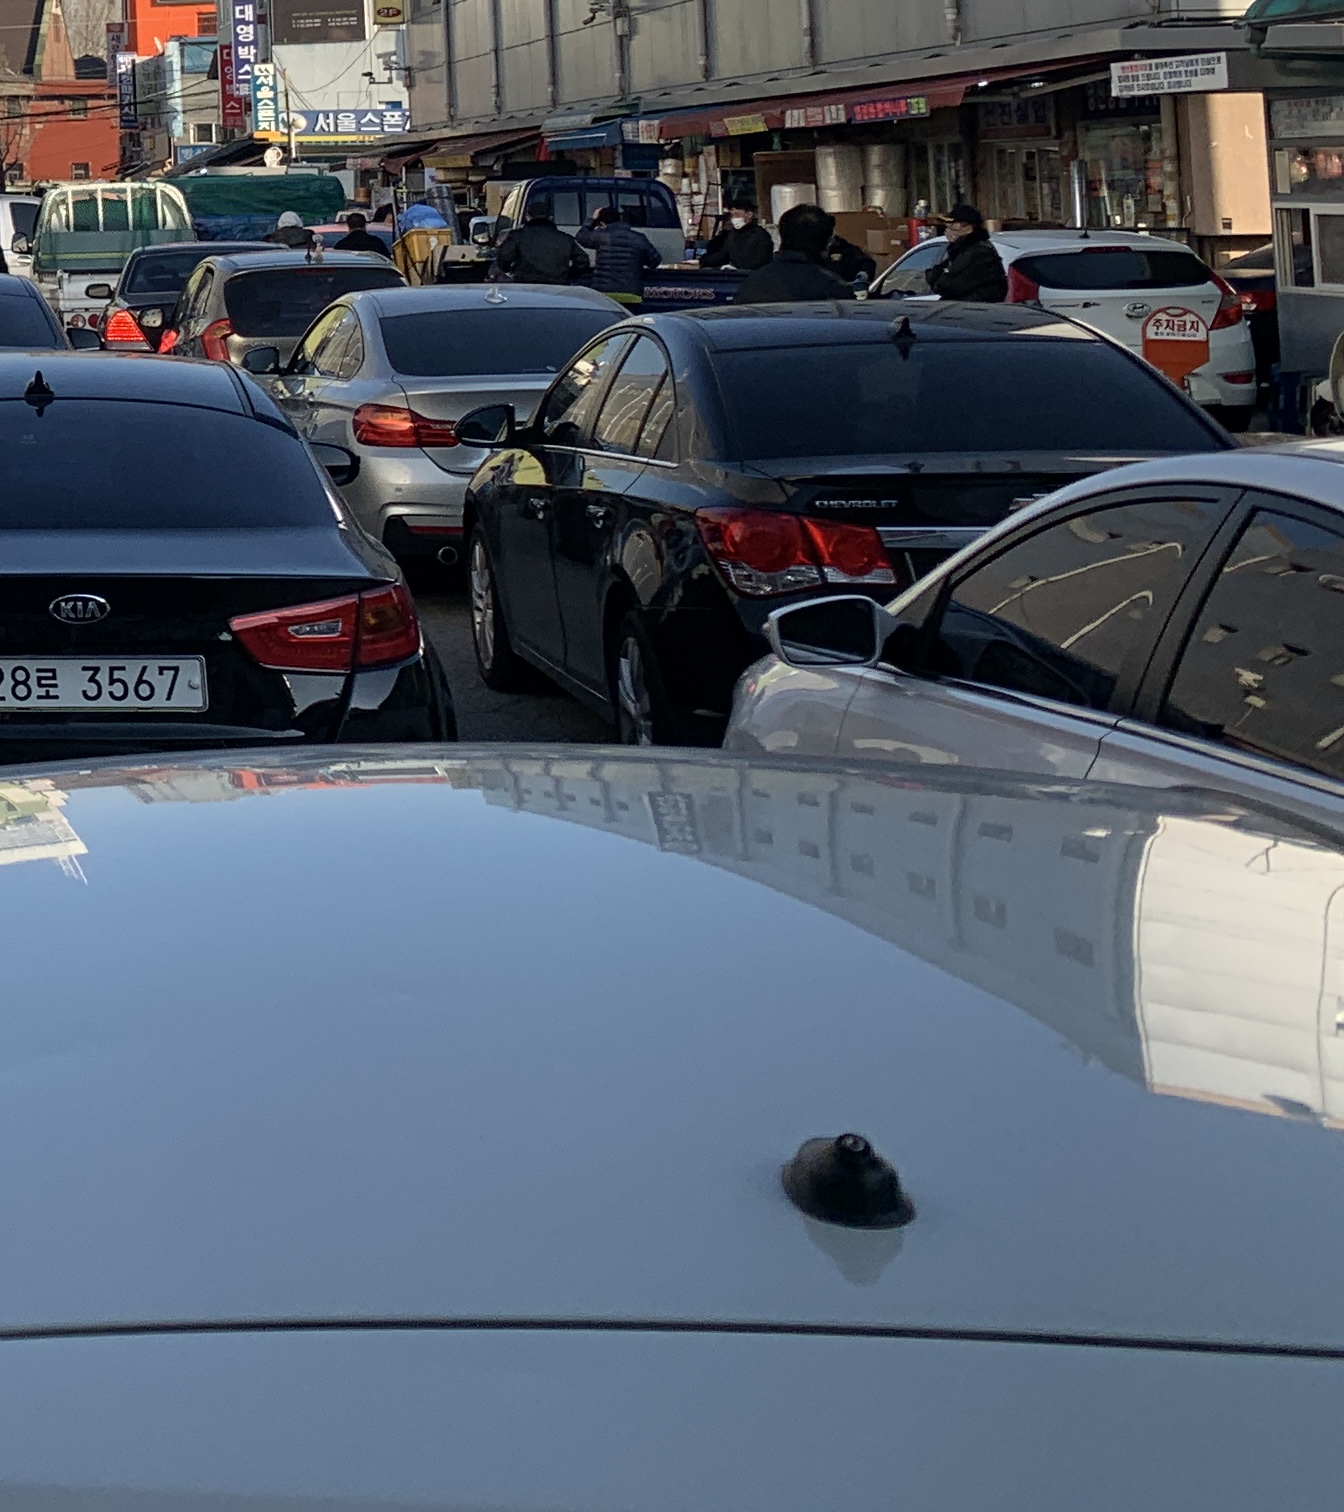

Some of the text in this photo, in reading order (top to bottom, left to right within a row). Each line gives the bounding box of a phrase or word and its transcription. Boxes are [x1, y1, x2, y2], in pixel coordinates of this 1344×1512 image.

[234, 3, 257, 80] 대영박스
[59, 601, 102, 619] KIA
[81, 664, 181, 702] 3567
